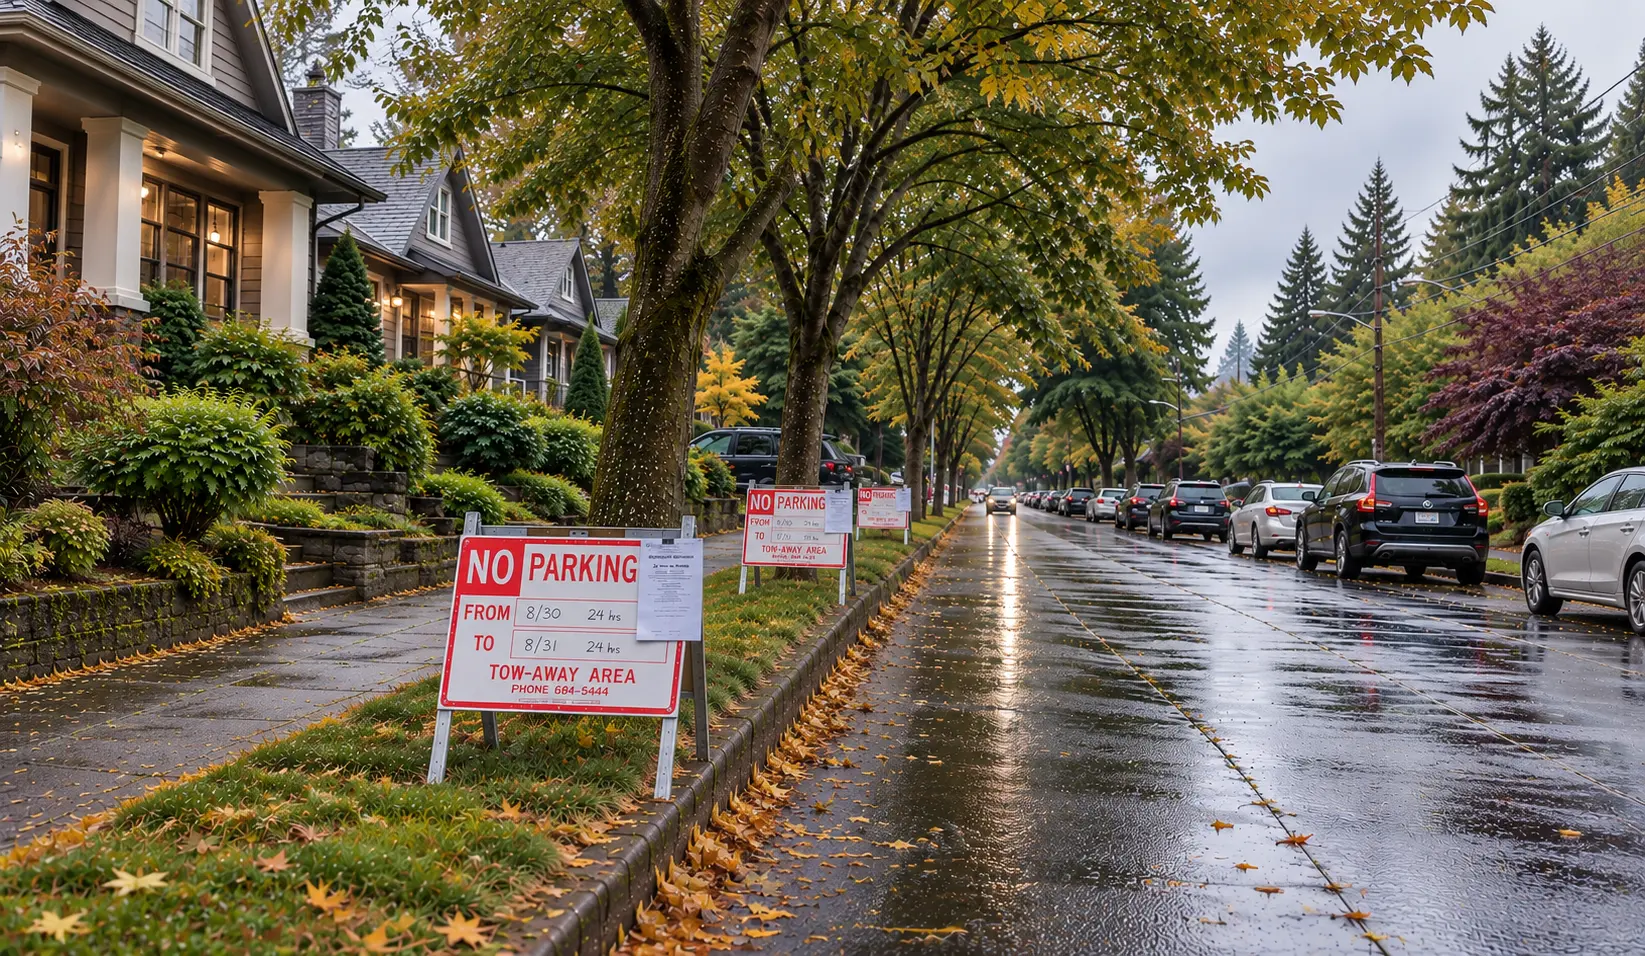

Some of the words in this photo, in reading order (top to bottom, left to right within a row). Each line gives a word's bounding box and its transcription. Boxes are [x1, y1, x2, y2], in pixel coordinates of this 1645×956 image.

[750, 493, 772, 511] NO
[777, 495, 826, 510] PARKING
[754, 531, 765, 540] TO
[466, 549, 515, 585] NO
[528, 552, 638, 584] PARKING
[463, 604, 511, 621] FROM
[526, 604, 562, 623] 8/30
[587, 608, 604, 621] 24
[608, 609, 622, 622] hrs
[474, 634, 495, 652] TO
[524, 636, 558, 655] 8/31
[586, 640, 604, 653] 24
[607, 641, 621, 654] hrs
[489, 663, 579, 683] TOW-AWAY
[588, 666, 636, 684] AREA
[511, 684, 549, 694] PHONE
